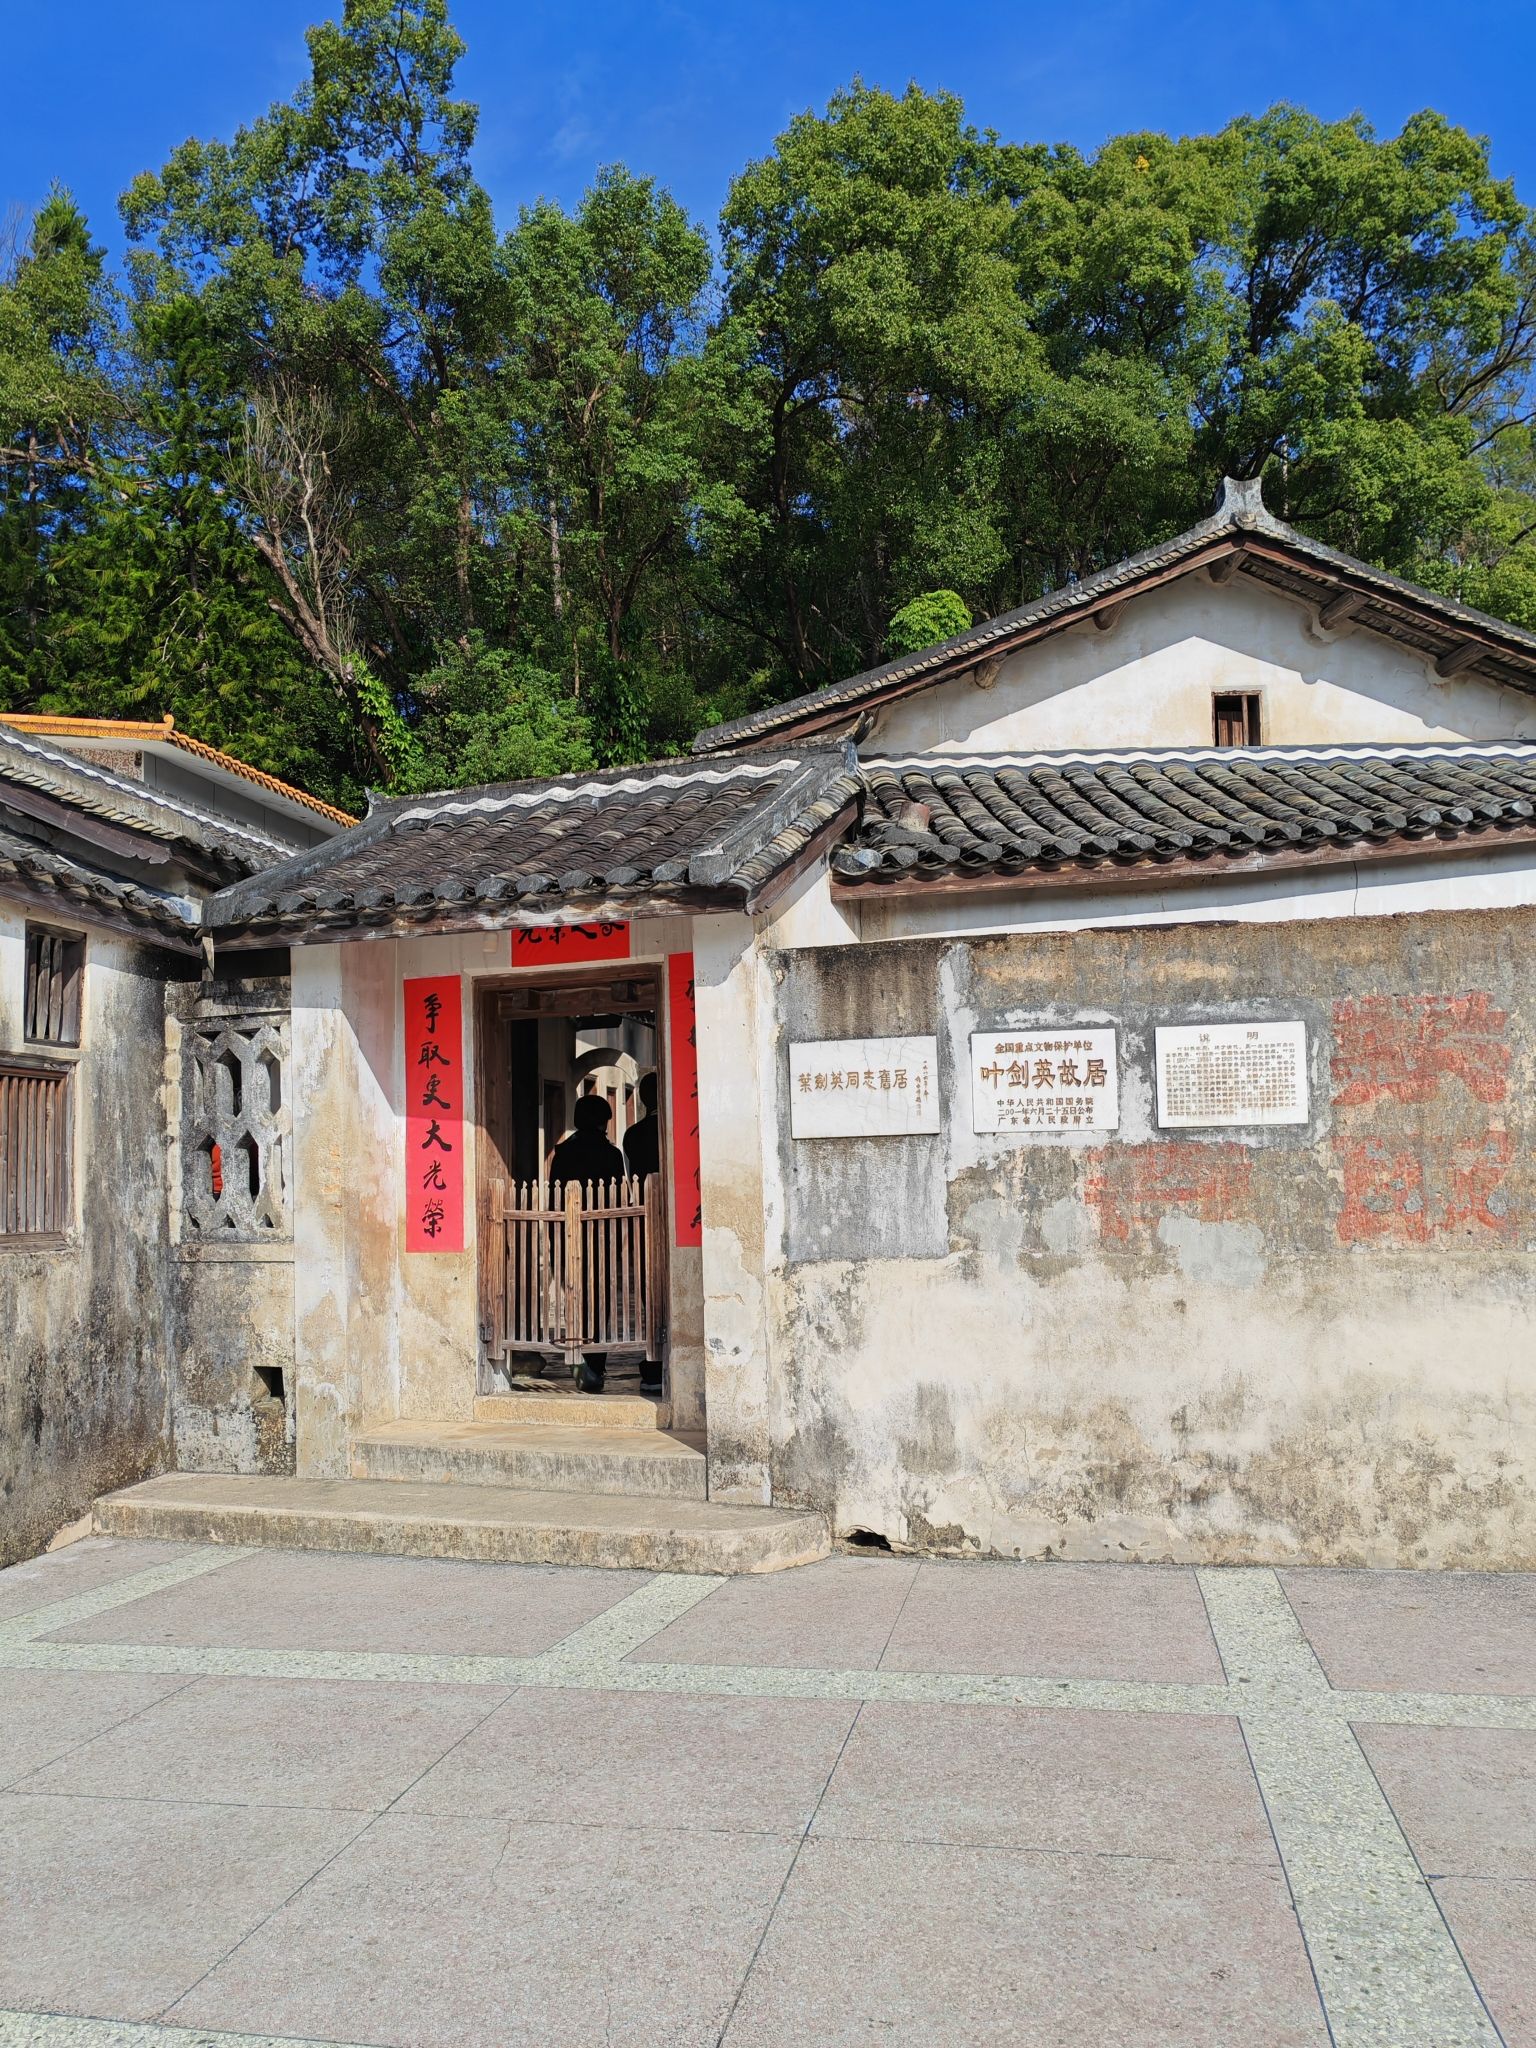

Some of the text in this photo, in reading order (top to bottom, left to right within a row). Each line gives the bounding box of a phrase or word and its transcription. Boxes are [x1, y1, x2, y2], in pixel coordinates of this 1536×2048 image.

[994, 1040, 1093, 1054] 全国重点文物保护单位
[980, 1058, 1107, 1090] 叶剑英故居
[996, 1097, 1094, 1107] 中华人民共和国国务院
[997, 1116, 1094, 1127] 广东省人民政府立
